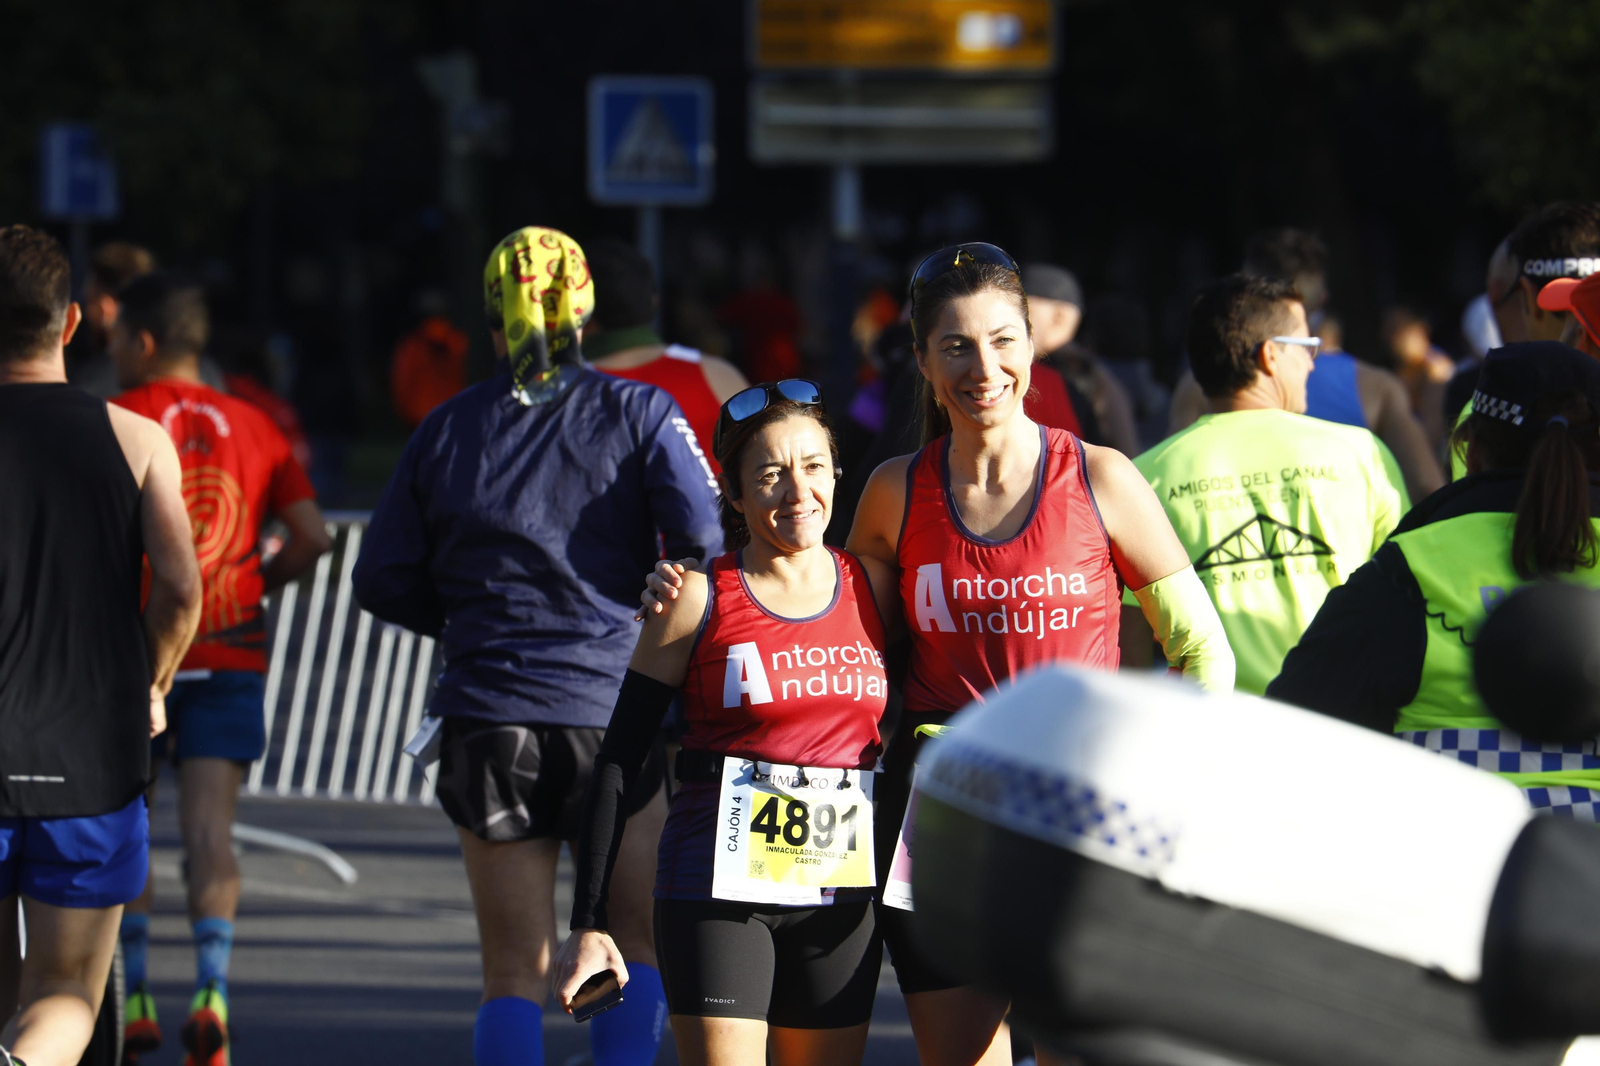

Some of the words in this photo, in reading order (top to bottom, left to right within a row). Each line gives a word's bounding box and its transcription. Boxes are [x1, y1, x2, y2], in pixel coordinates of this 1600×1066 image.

[1168, 475, 1234, 501] AMIGOS
[1241, 471, 1273, 488] DEL
[1280, 465, 1338, 482] CANAL
[772, 774, 829, 789] IMDCO
[732, 796, 743, 804] 4
[727, 807, 742, 852] CAJÓN
[750, 796, 858, 852] 4891
[765, 845, 813, 856] INMACULADA
[794, 857, 822, 866] CASTRO
